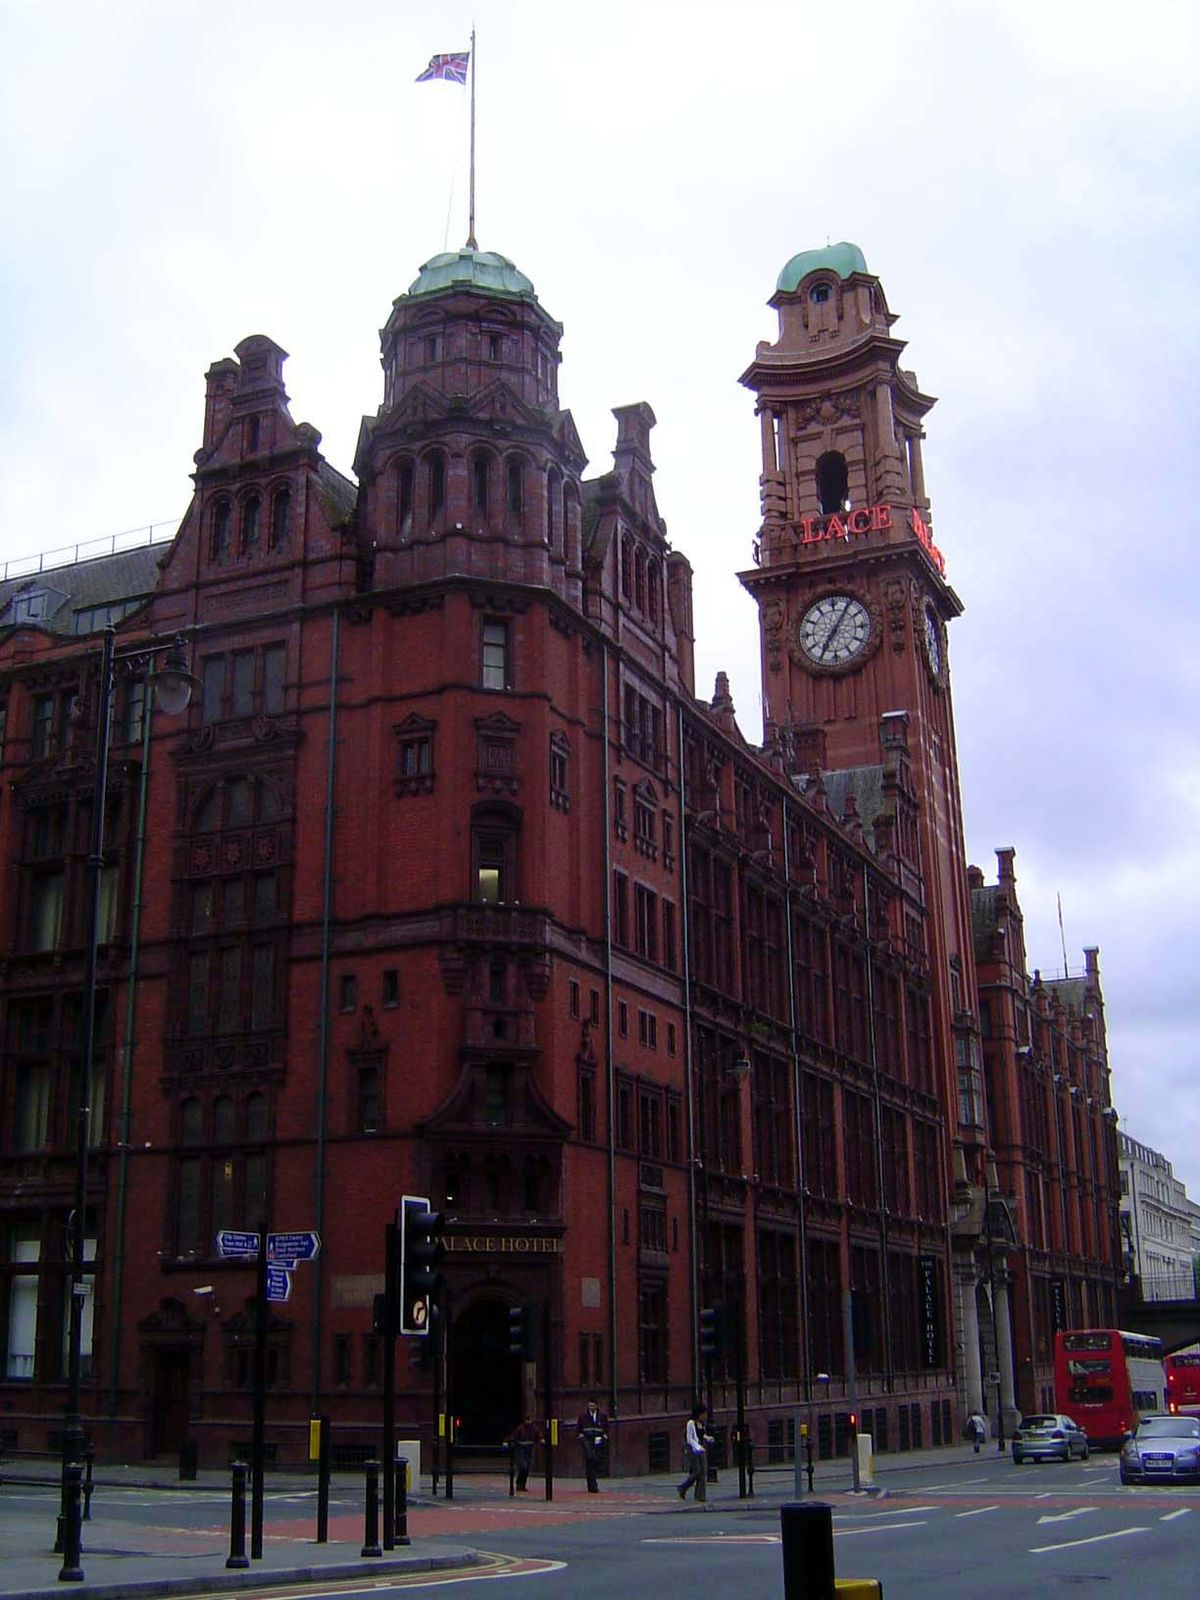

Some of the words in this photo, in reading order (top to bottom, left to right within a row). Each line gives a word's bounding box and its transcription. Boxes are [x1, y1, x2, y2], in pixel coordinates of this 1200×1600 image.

[434, 1236, 497, 1252] ALACE
[501, 1237, 562, 1252] HOTEL
[926, 1323, 936, 1364] HOTEL
